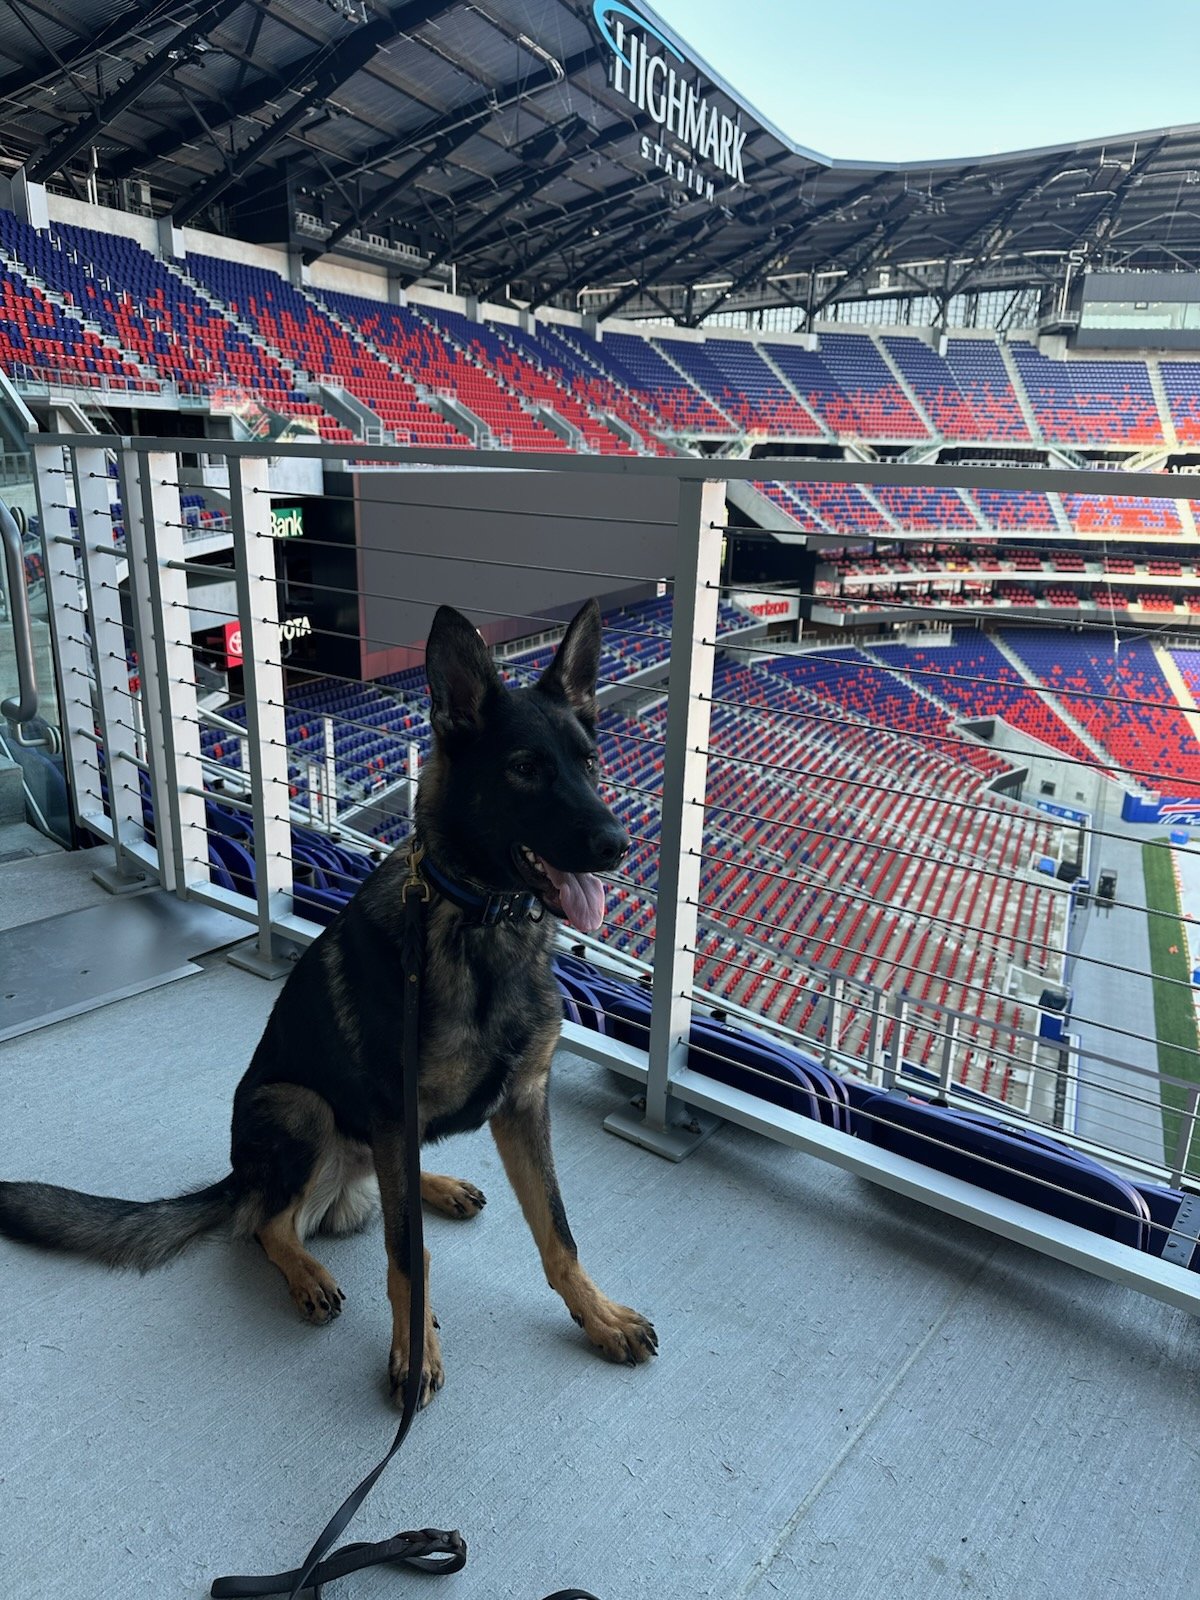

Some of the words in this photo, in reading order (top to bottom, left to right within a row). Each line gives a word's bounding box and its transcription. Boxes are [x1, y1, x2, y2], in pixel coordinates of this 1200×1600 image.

[614, 20, 748, 184] HIGHMARK
[641, 136, 715, 203] STADIUM
[270, 510, 304, 538] Bank
[280, 616, 312, 642] YOTA
